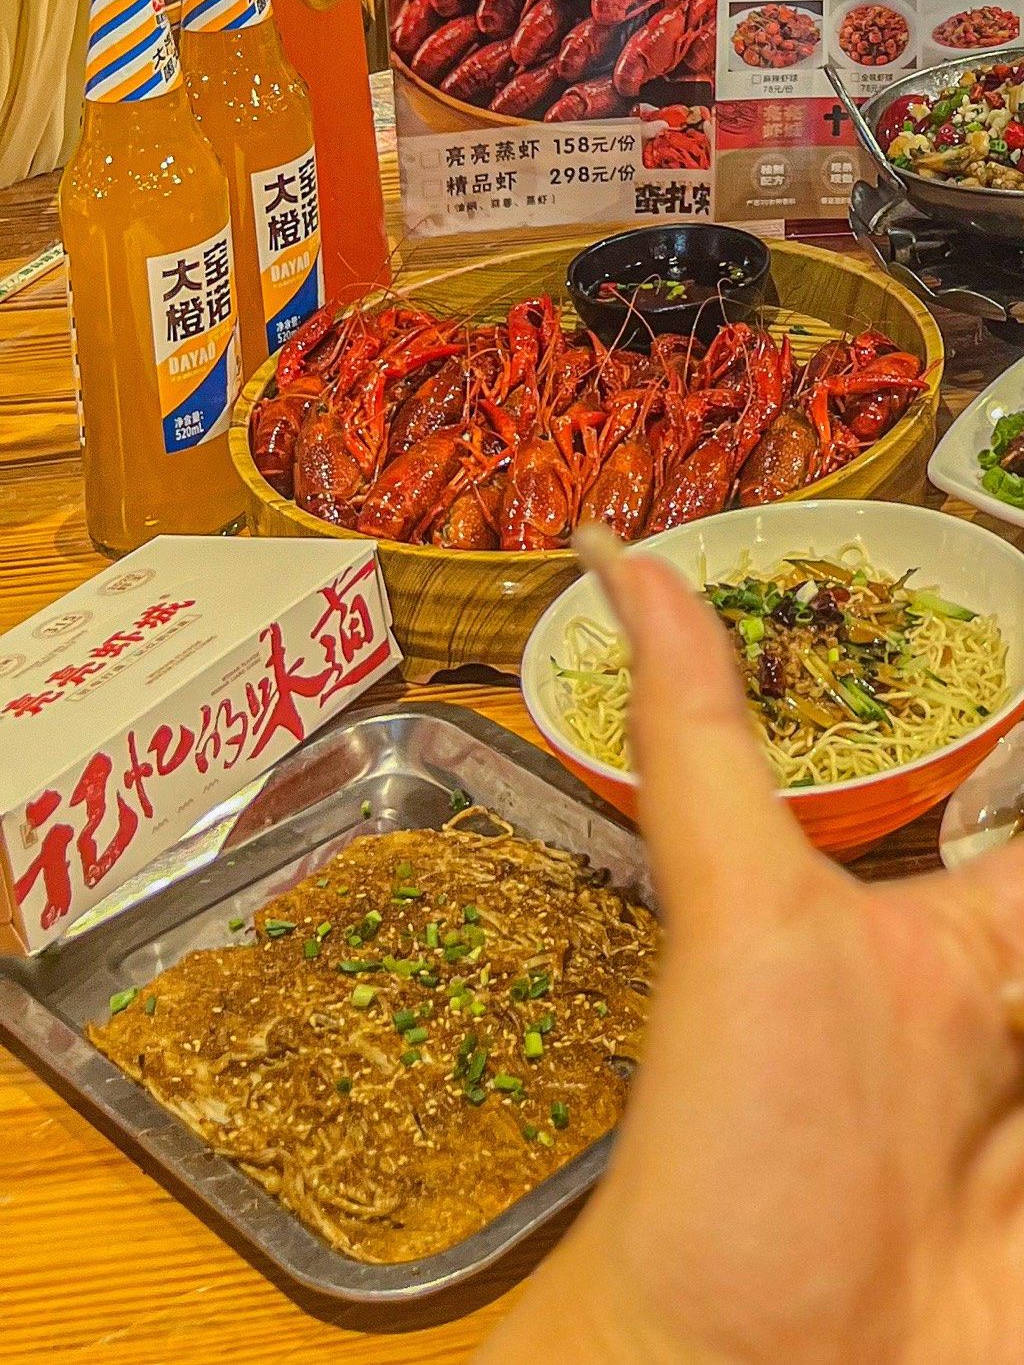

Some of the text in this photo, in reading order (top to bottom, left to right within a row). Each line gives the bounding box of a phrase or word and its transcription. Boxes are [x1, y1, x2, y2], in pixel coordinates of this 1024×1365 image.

[446, 135, 636, 167] 亮亮蒸虾 158元/份
[446, 164, 636, 196] 精品虾 298元/份
[162, 238, 231, 302] 大窑
[270, 250, 310, 283] DAYAO
[166, 279, 232, 342] 橙诺
[169, 341, 216, 376] DAYAO
[1, 599, 196, 720] 亮亮虾城
[14, 558, 393, 930] 记忆的味道
